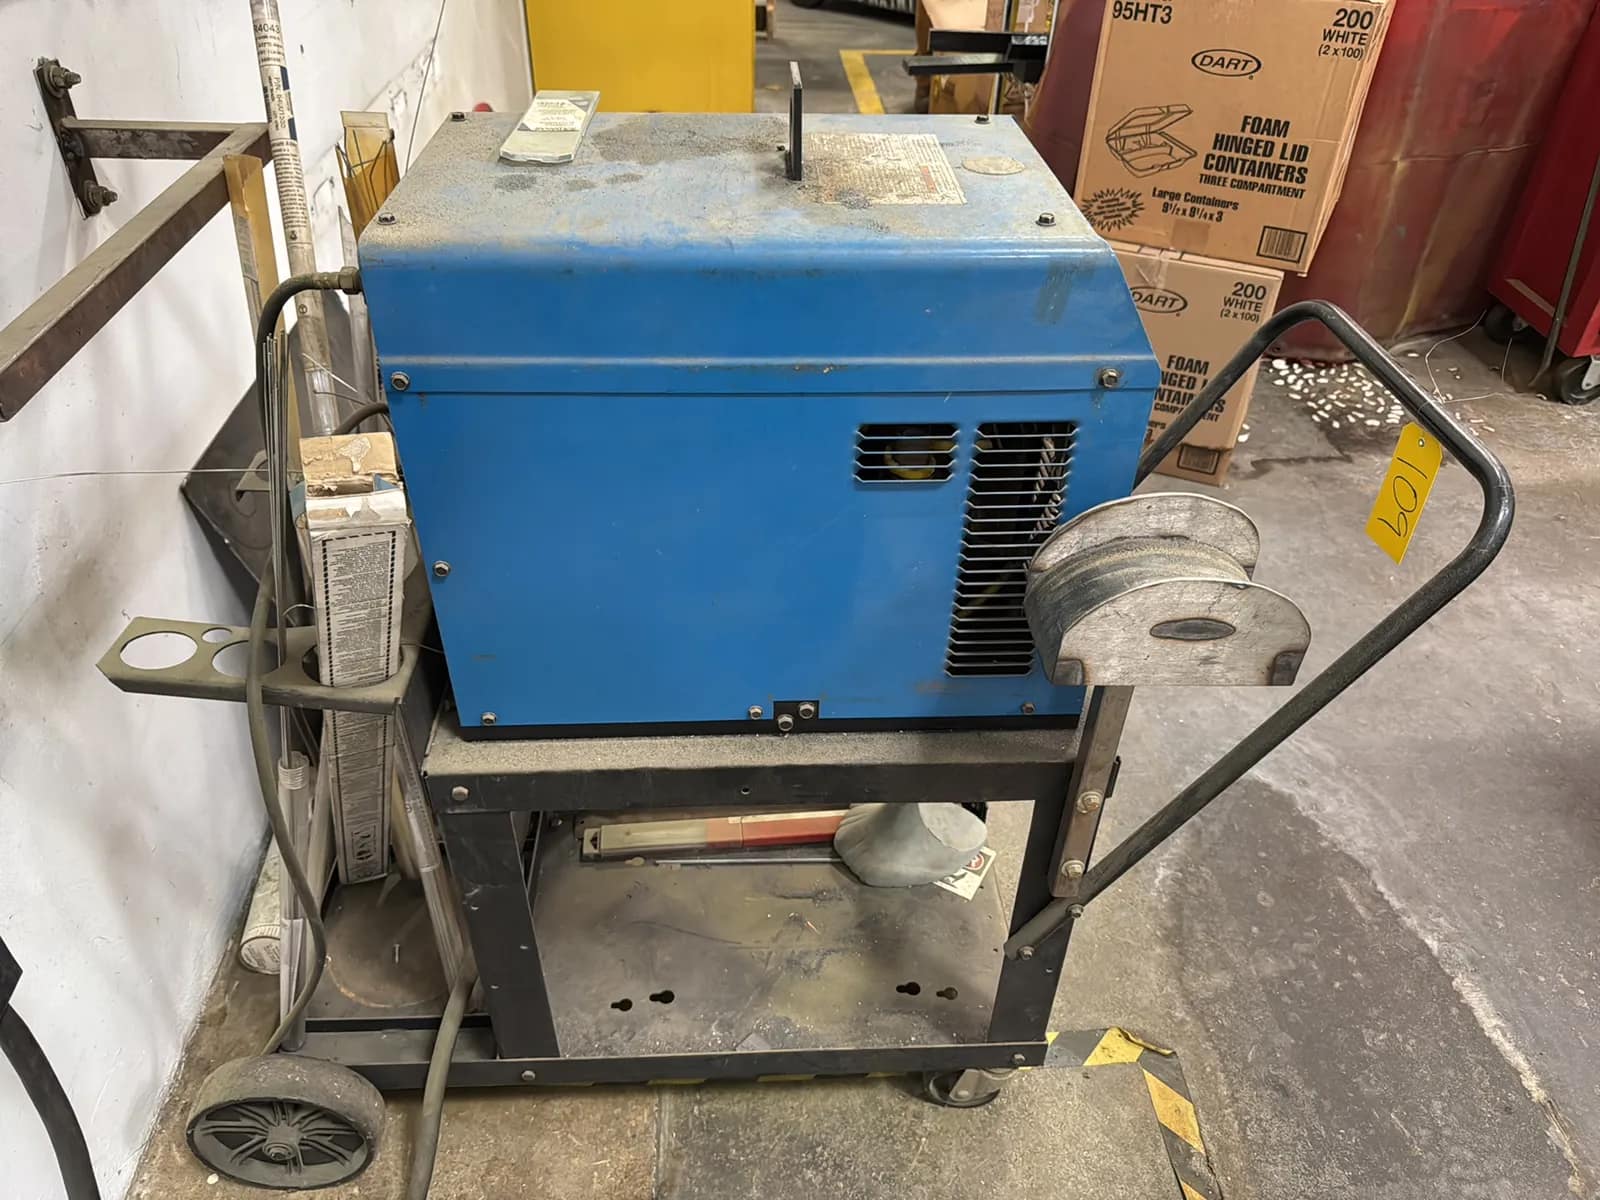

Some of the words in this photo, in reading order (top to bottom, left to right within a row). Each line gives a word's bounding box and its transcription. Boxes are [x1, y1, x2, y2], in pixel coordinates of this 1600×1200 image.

[1112, 0, 1172, 24] 95HT3
[1333, 8, 1373, 30] 200
[1323, 29, 1368, 45] WHITE
[1200, 54, 1253, 71] DART
[1318, 44, 1330, 57] (2
[1332, 48, 1340, 56] x
[1341, 47, 1364, 60] 100)
[1240, 115, 1290, 138] FOAM
[1212, 133, 1275, 158] HINGED
[1280, 142, 1309, 162] LID
[1203, 153, 1308, 184] CONTAINERS
[1199, 173, 1228, 187] THREE
[1230, 178, 1306, 199] COMPARTMENT
[1152, 186, 1181, 201] Large
[1184, 192, 1239, 211] Containers
[1181, 208, 1187, 216] x
[1216, 210, 1223, 222] 3
[1232, 282, 1266, 300] 200
[1223, 296, 1263, 312] WHITE
[1220, 308, 1231, 319] (2
[1240, 311, 1260, 324] 100)
[1167, 355, 1209, 376] FOAM
[1377, 457, 1428, 537] 109
